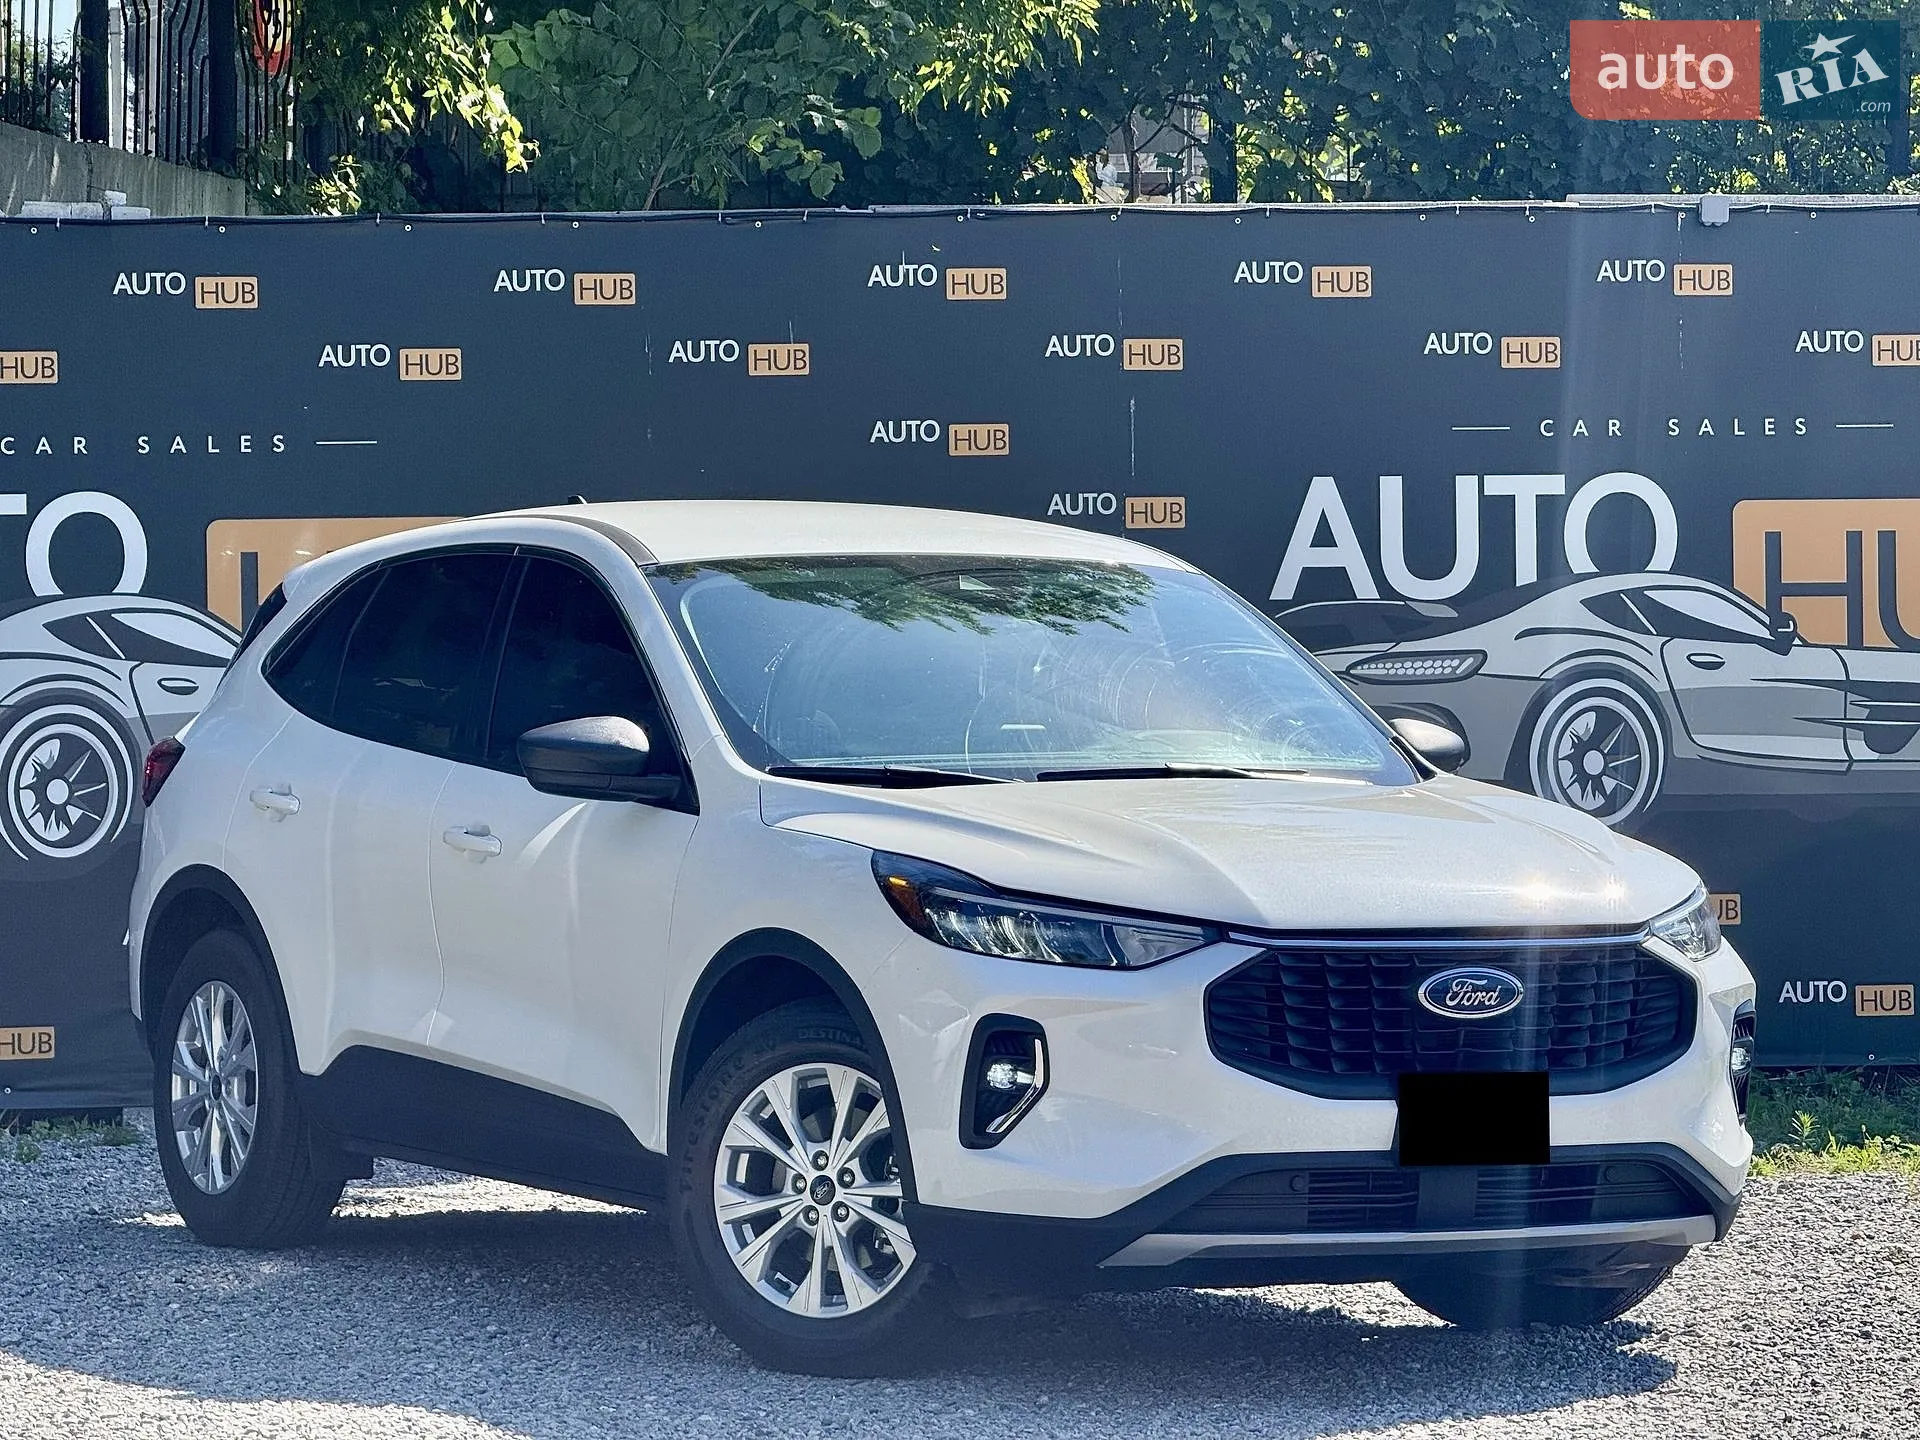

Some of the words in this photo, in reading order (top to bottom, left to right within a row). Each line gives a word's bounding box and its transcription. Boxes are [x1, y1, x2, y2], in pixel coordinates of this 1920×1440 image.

[113, 272, 186, 295] AUTO
[200, 281, 256, 304] HUB
[494, 269, 565, 292] AUTO
[579, 278, 634, 301] HUB
[868, 264, 937, 288] AUTO
[951, 273, 1005, 296] HUB
[1234, 261, 1303, 284] AUTO
[1316, 271, 1369, 294] HUB
[1597, 259, 1665, 282] AUTO
[1678, 269, 1731, 292] HUB
[318, 344, 390, 367] AUTO
[404, 353, 459, 376] HUB
[669, 340, 739, 363] AUTO
[753, 348, 807, 372] HUB
[1045, 334, 1114, 357] AUTO
[1128, 343, 1181, 366] HUB
[1424, 332, 1492, 355] AUTO
[1506, 342, 1558, 364] HUB
[1796, 330, 1864, 353] AUTO
[1878, 340, 1920, 361] HU
[0, 356, 56, 379] HUB
[870, 420, 940, 443] AUTO
[953, 428, 1008, 451] HUB
[1540, 419, 1622, 437] CAR
[1668, 417, 1808, 436] SALES
[0, 436, 88, 455] CAR
[138, 434, 285, 454] SALES
[1048, 492, 1117, 516] AUTO
[1130, 501, 1183, 525] HUB
[1269, 472, 1677, 601] AUTO
[1446, 978, 1502, 1006] Ford
[1779, 981, 1847, 1003] AUTO
[1860, 990, 1912, 1012] HUB
